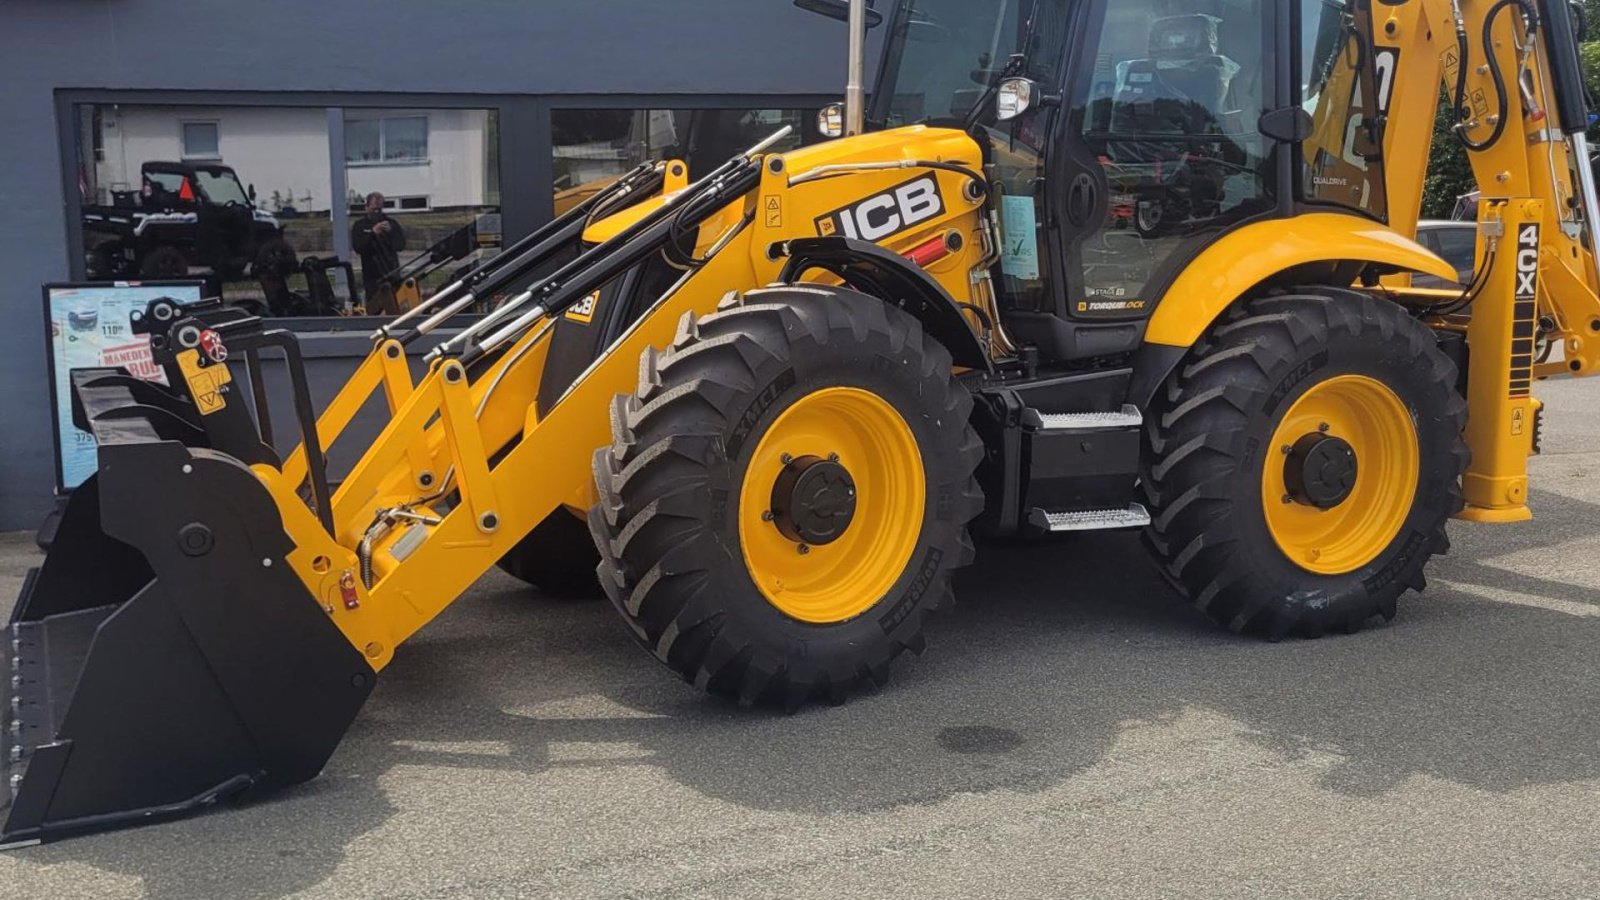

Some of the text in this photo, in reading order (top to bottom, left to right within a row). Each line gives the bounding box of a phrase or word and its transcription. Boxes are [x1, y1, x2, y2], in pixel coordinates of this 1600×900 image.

[839, 178, 941, 241] JCB
[1515, 225, 1538, 295] 4CX
[1088, 301, 1145, 311] TORQUELOCK
